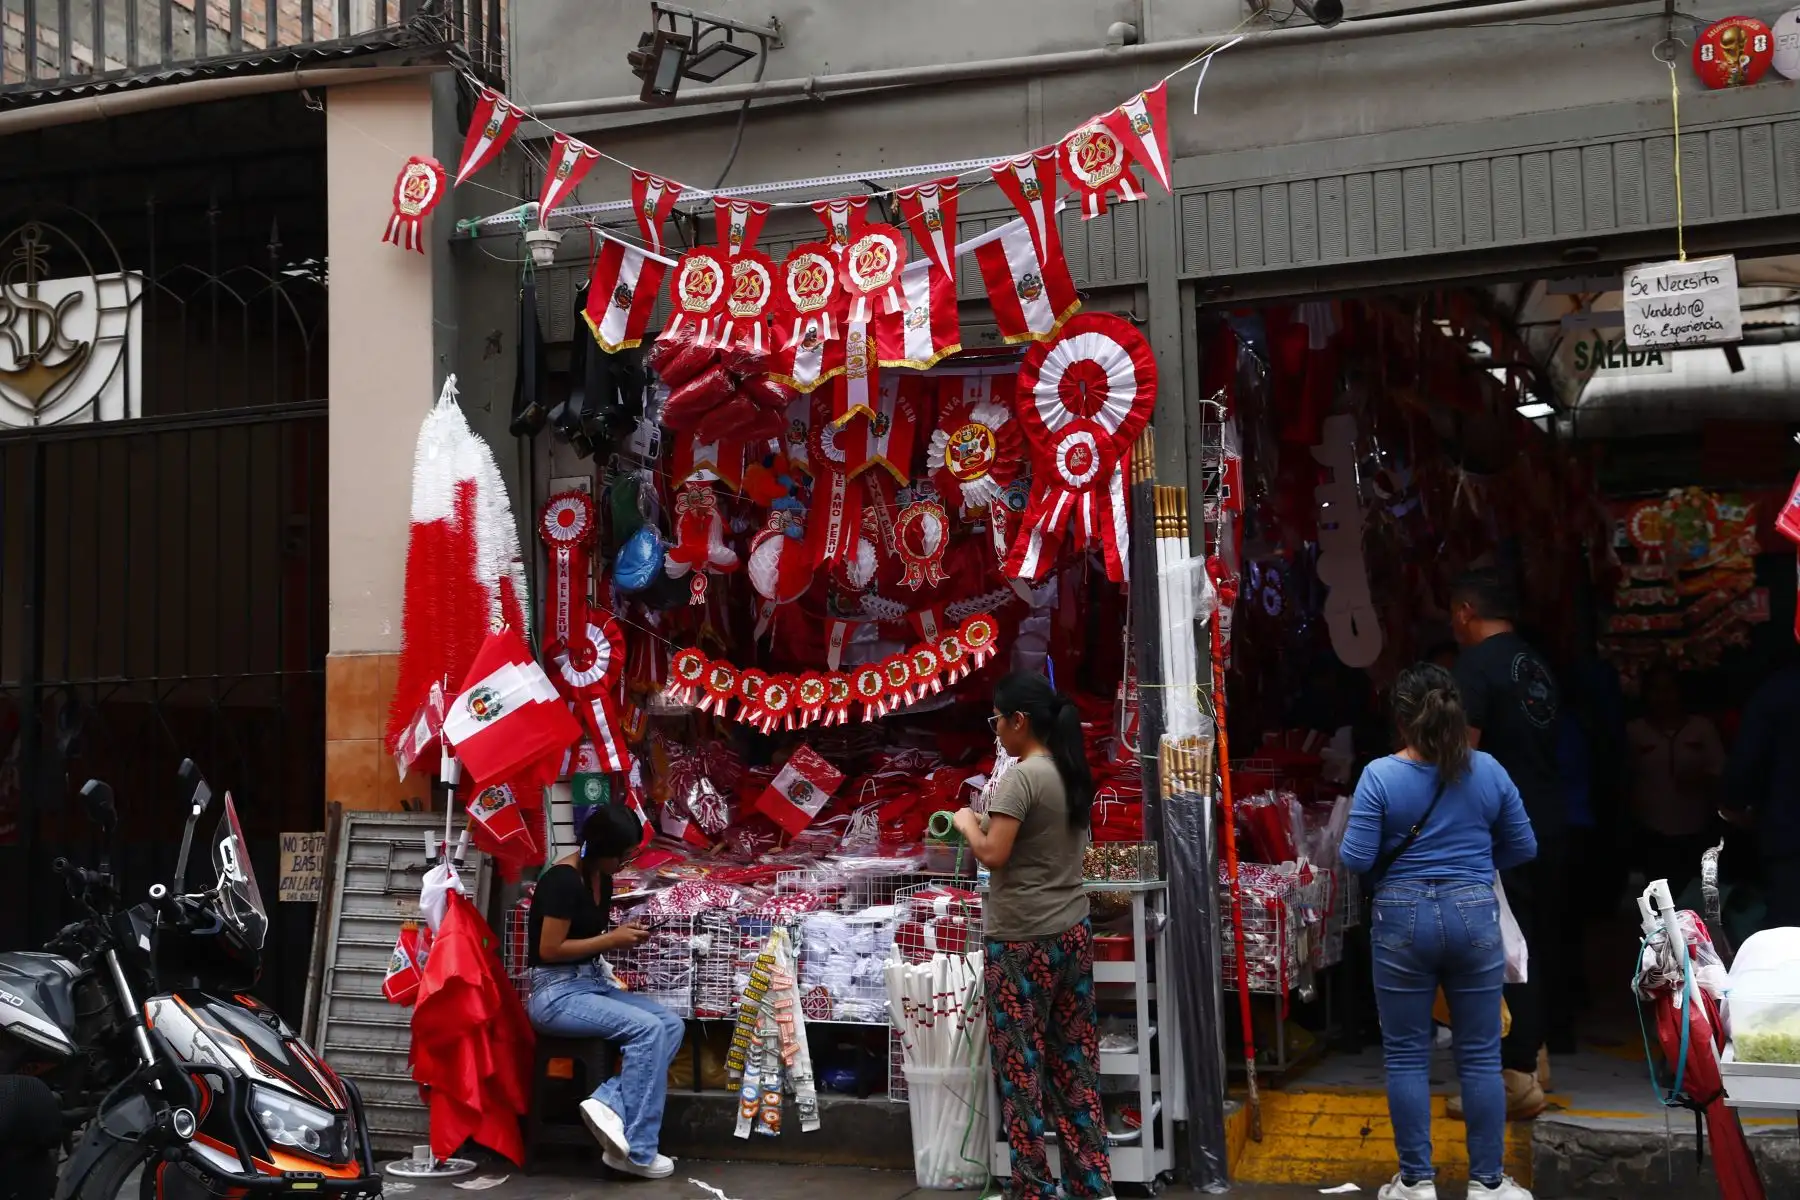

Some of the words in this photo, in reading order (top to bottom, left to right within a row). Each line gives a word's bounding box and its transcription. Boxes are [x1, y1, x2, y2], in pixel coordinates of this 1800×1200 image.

[1082, 135, 1114, 172] 28
[859, 245, 888, 275] 28
[686, 270, 716, 295] 28
[732, 275, 762, 298] 28
[797, 266, 826, 294] 28
[1630, 275, 1649, 296] Se
[1656, 271, 1720, 293] Necesita
[833, 473, 845, 488] TE
[832, 494, 844, 517] AMO
[826, 523, 841, 555] PERU
[558, 551, 568, 578] VIVA
[560, 582, 567, 599] EL
[556, 601, 568, 633] PERU
[283, 836, 297, 853] NO
